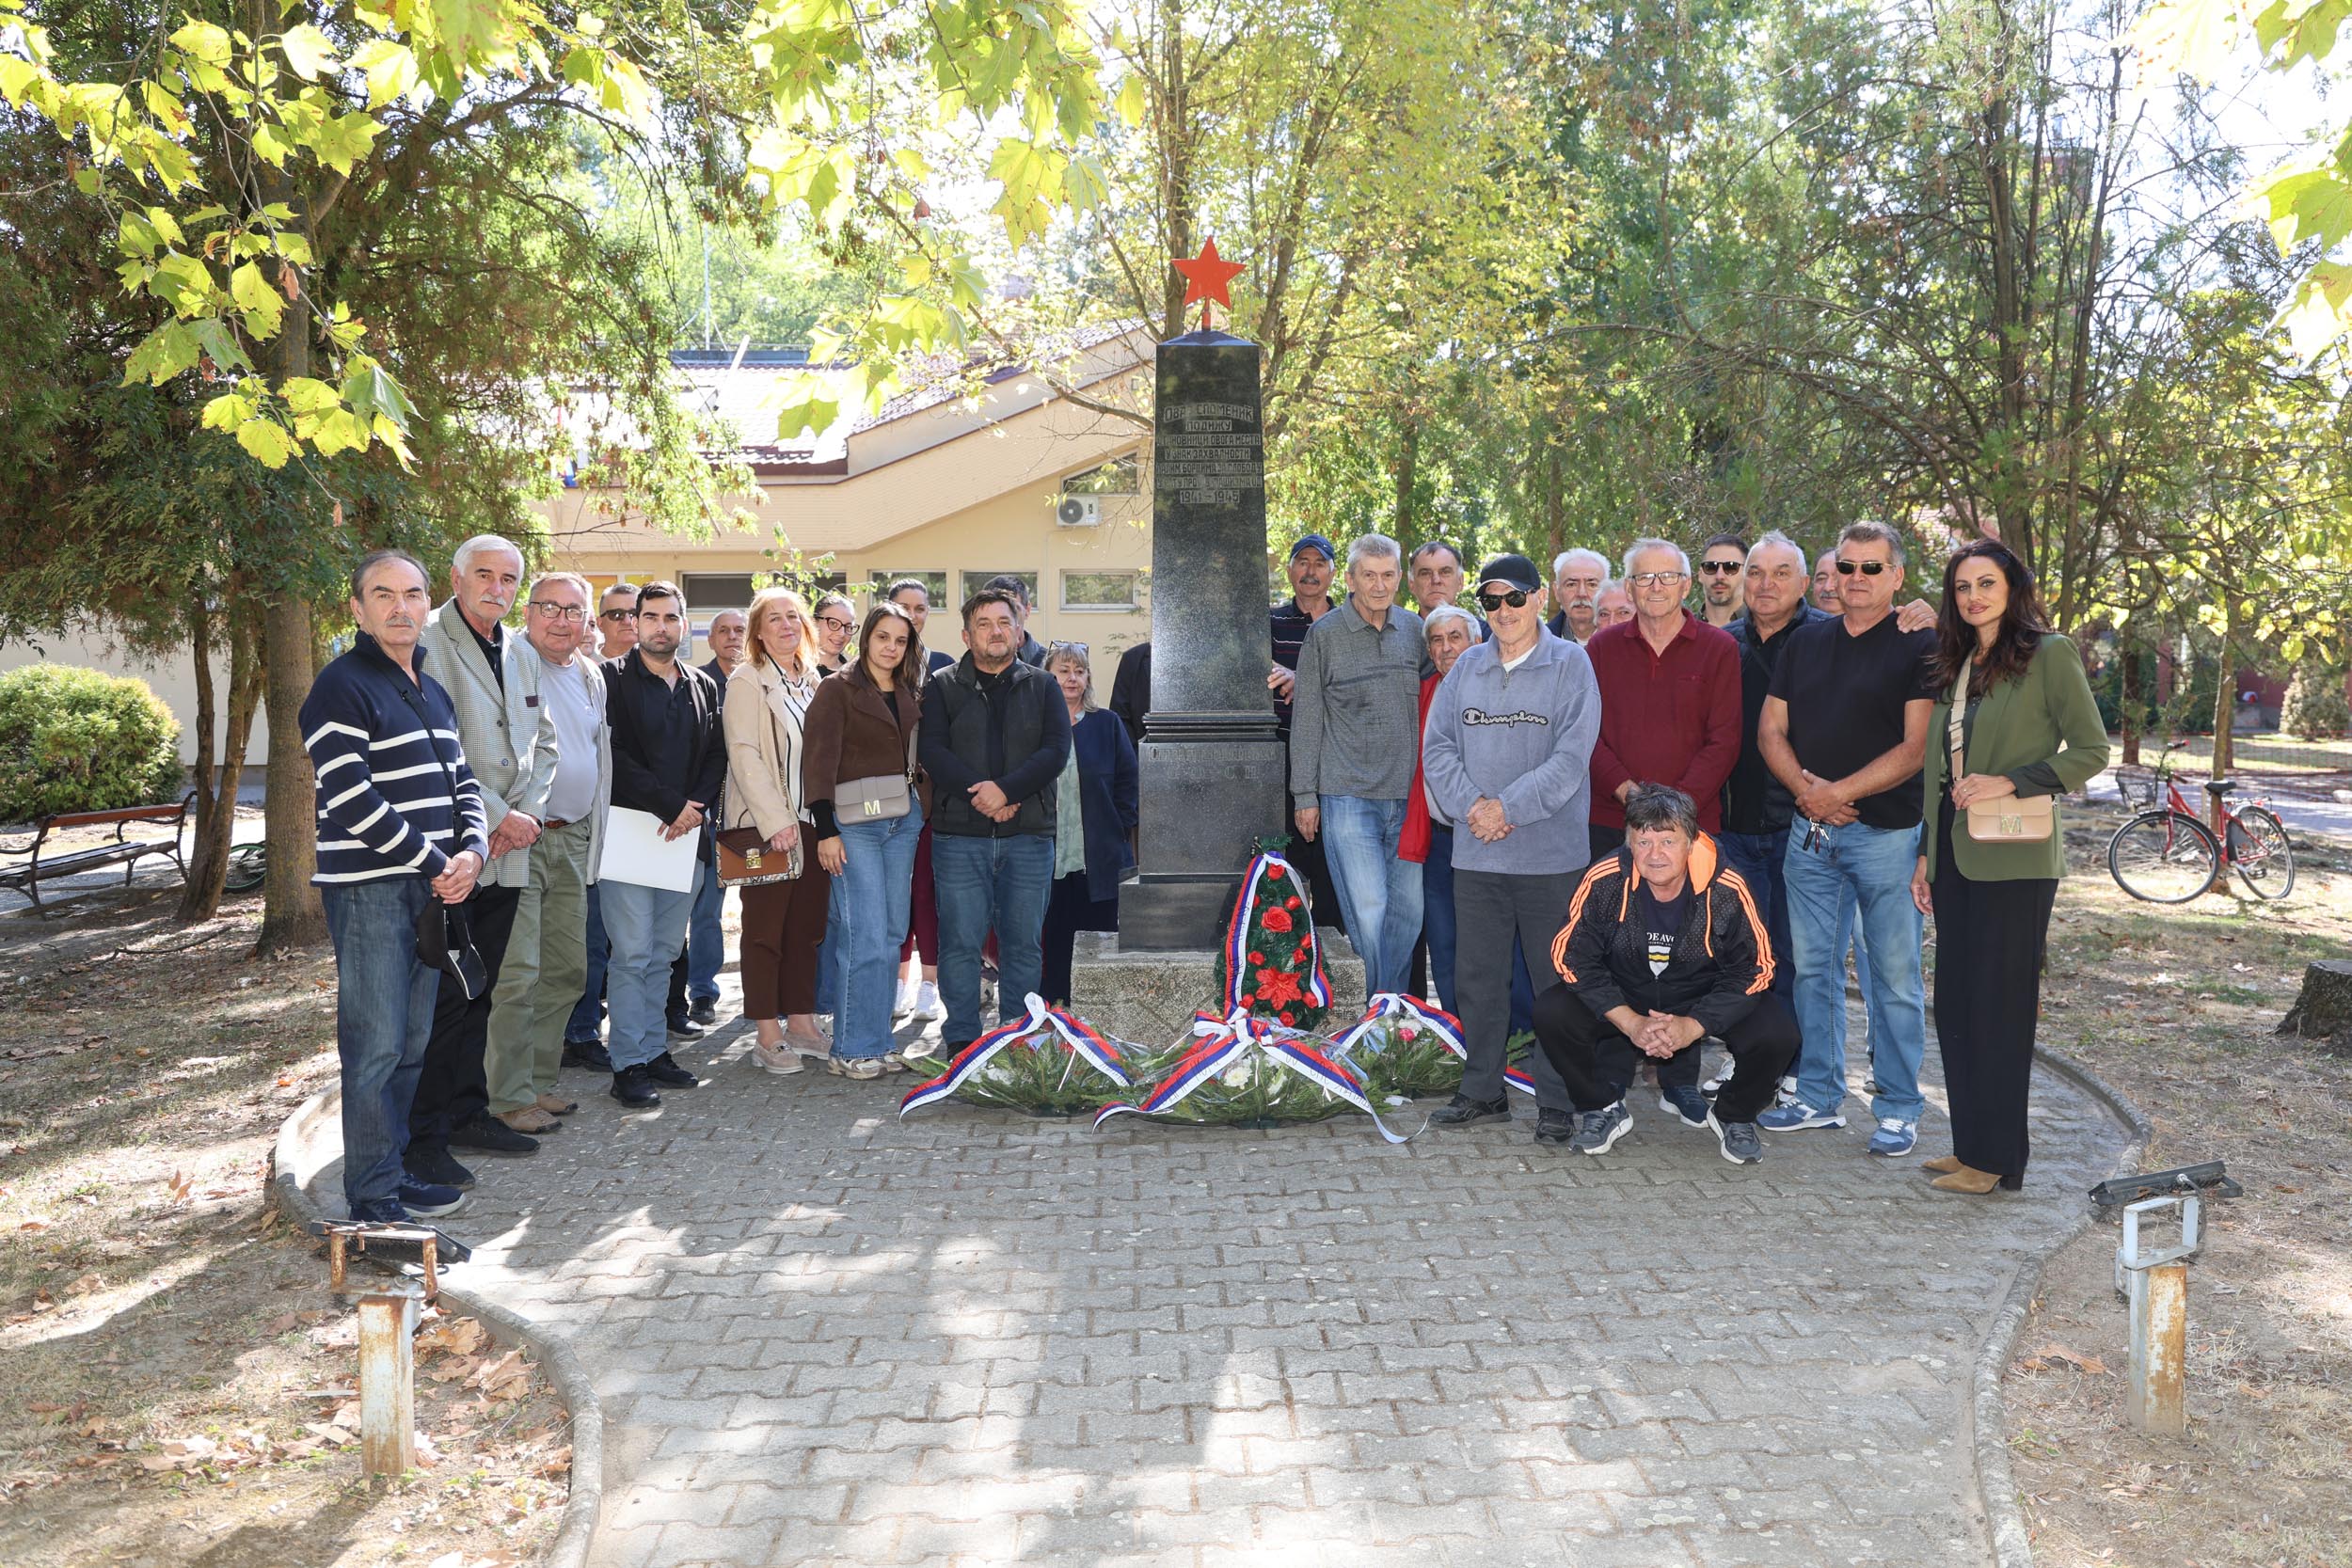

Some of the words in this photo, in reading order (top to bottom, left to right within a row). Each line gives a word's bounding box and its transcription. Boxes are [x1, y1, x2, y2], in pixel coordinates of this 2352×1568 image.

[1165, 405, 1192, 422] ОВА
[1196, 404, 1253, 421] СПОМЕНИК
[1187, 420, 1232, 431] ПОДИЖУ
[1211, 435, 1234, 445] ОВОГА
[1236, 434, 1260, 445] МЕСТА
[1173, 449, 1192, 459] ЗНАК
[1181, 491, 1201, 503] 1941
[1215, 490, 1239, 502] 1945
[1463, 707, 1549, 727] Champion
[864, 800, 882, 816] M
[2001, 815, 2022, 835] M
